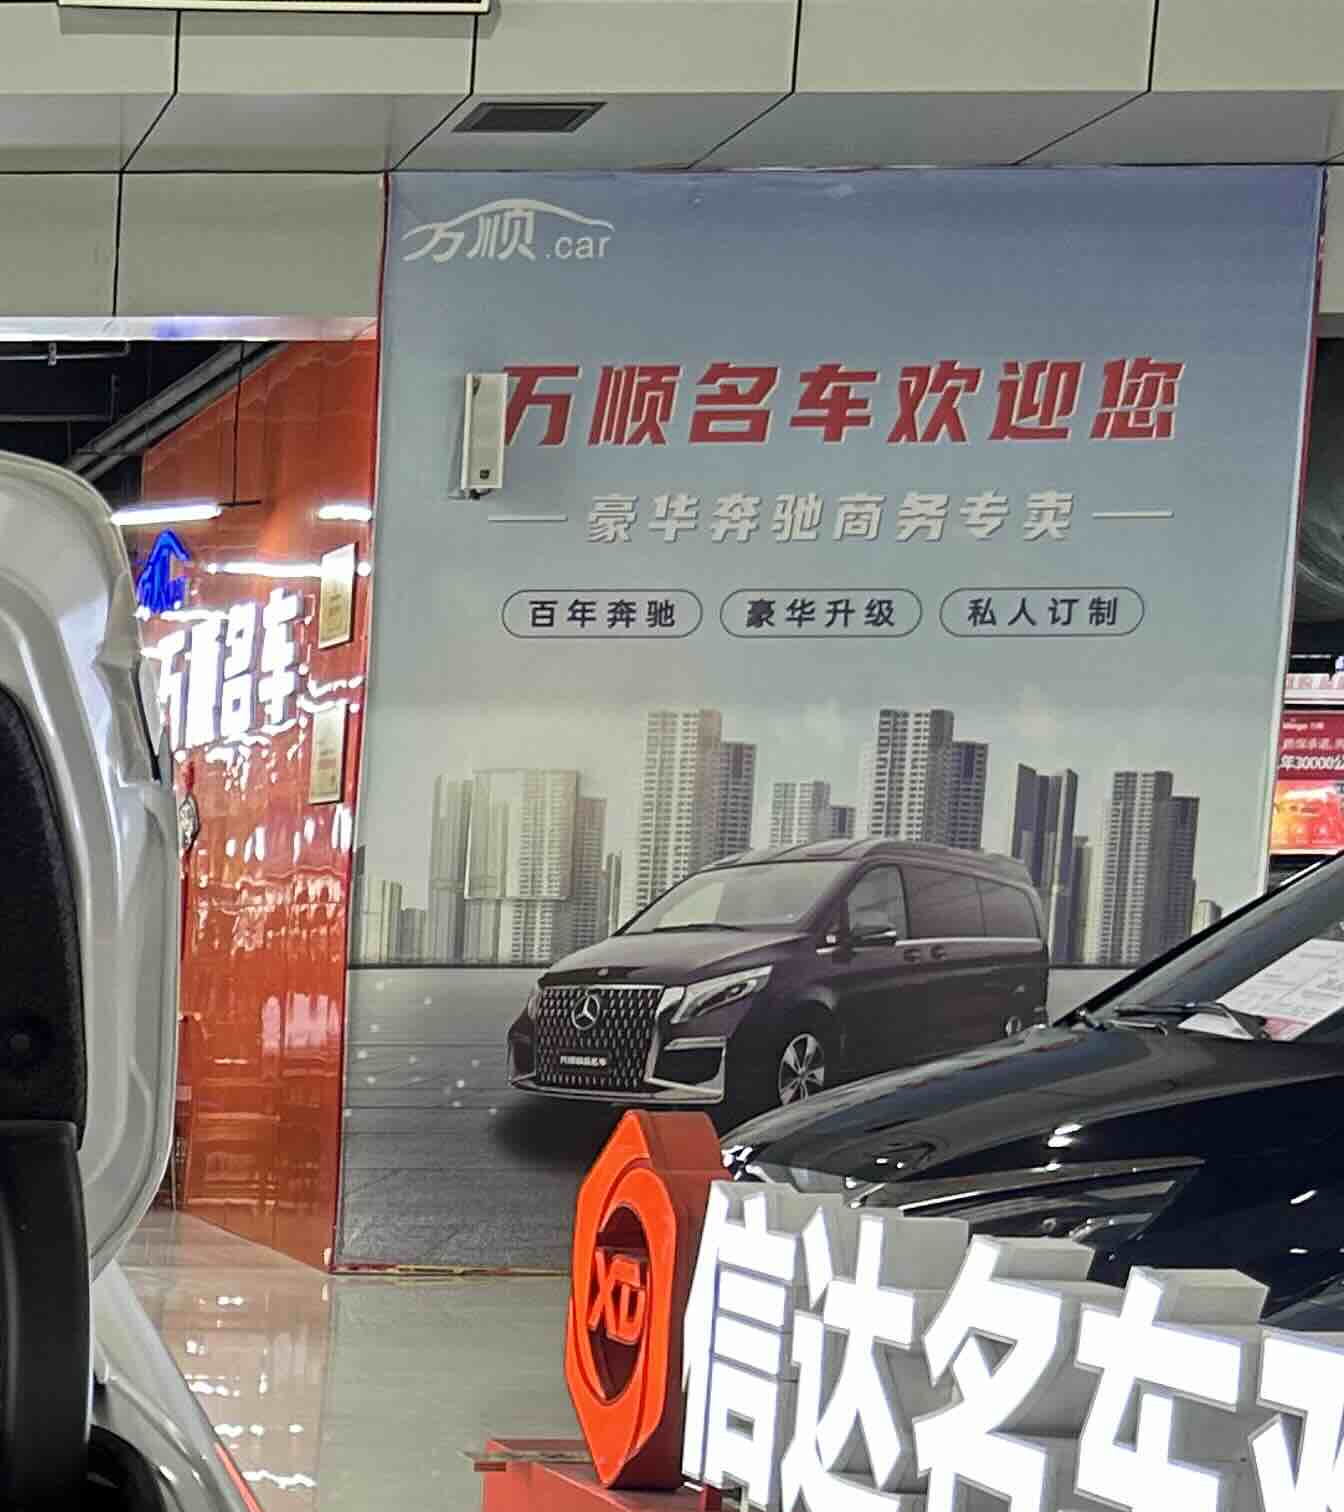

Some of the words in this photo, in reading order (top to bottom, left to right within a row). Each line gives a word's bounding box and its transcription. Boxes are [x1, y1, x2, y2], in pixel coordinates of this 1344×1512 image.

[402, 202, 538, 263] 万顺
[499, 355, 1187, 448] 万顺名车欢迎您
[586, 489, 1077, 546] 豪华奔驰商务专卖
[527, 598, 679, 632] 百年奔驰
[744, 597, 898, 632] 豪华升级
[966, 596, 1121, 631] 私人订制
